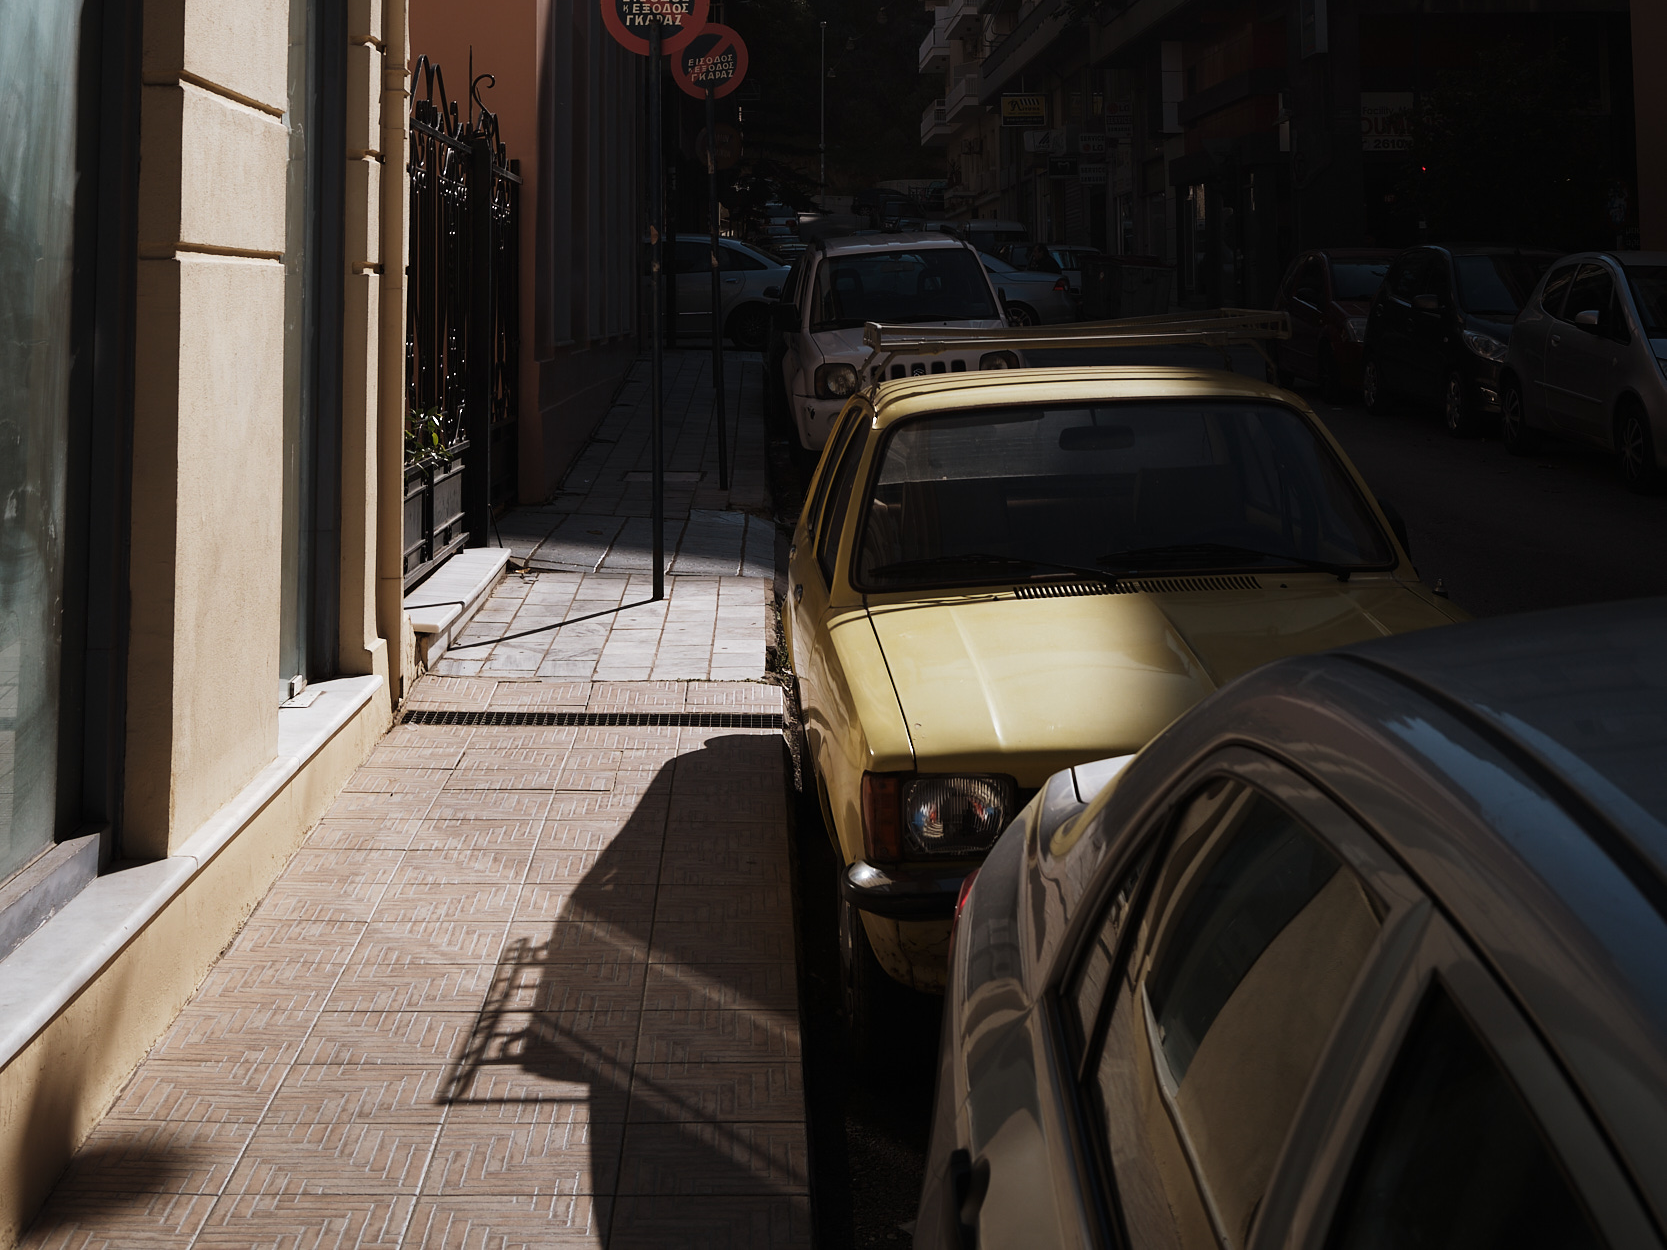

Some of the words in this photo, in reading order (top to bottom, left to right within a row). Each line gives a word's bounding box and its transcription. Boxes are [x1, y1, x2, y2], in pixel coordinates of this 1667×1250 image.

[688, 54, 733, 66] ΕΙΣΟΔΟΣ
[691, 69, 734, 82] ΓΚΑΡΑΖ
[1362, 106, 1394, 116] Facility
[1107, 116, 1132, 124] SERVICE
